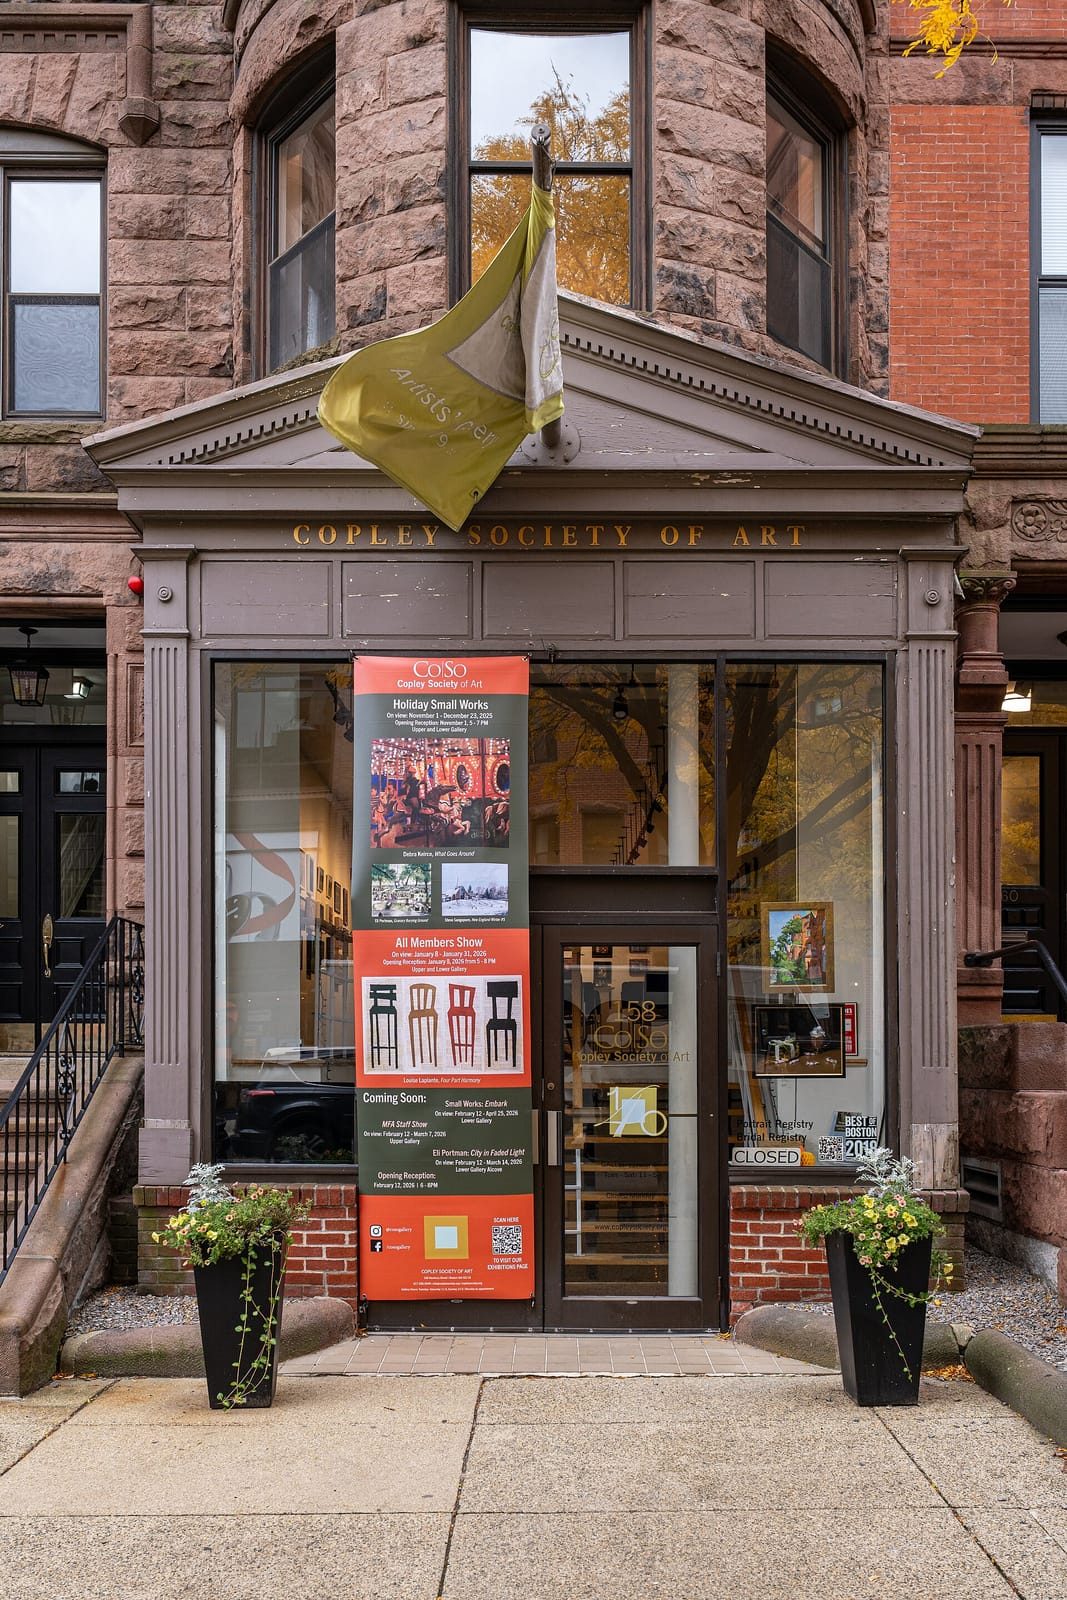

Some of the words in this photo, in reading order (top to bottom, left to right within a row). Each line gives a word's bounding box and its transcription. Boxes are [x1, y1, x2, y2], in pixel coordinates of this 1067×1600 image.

[390, 367, 462, 423] Artists'
[293, 524, 440, 546] COPLEY
[468, 525, 632, 546] SOCIETY
[660, 525, 705, 546] OF
[732, 525, 806, 546] ART
[398, 679, 425, 690] Copley
[428, 679, 458, 690] Society
[461, 680, 468, 688] of
[471, 680, 482, 688] Art
[394, 699, 428, 712] Holiday
[431, 699, 457, 710] Small
[460, 699, 488, 710] Works
[396, 937, 408, 948] All
[410, 937, 454, 948] Members
[457, 937, 482, 947] Show
[473, 950, 487, 959] 2026
[614, 1000, 657, 1022] 158
[574, 1051, 610, 1063] opley
[614, 1051, 657, 1063] Society
[672, 1052, 690, 1062] Art
[363, 1093, 398, 1105] Coming
[400, 1093, 426, 1103] Soon:
[455, 1110, 475, 1118] February
[737, 1120, 771, 1129] Portrait
[776, 1120, 814, 1130] Registry
[845, 1116, 867, 1127] BEST
[868, 1117, 877, 1126] OF
[845, 1127, 877, 1137] BOSTON
[737, 1133, 765, 1141] Bridal
[769, 1133, 807, 1143] Registry
[442, 1149, 470, 1157] Portman:
[470, 1149, 482, 1158] City
[510, 1149, 525, 1157] Light
[734, 1151, 799, 1164] CLOSED
[378, 1172, 403, 1180] Opening
[403, 1172, 436, 1180] Reception:
